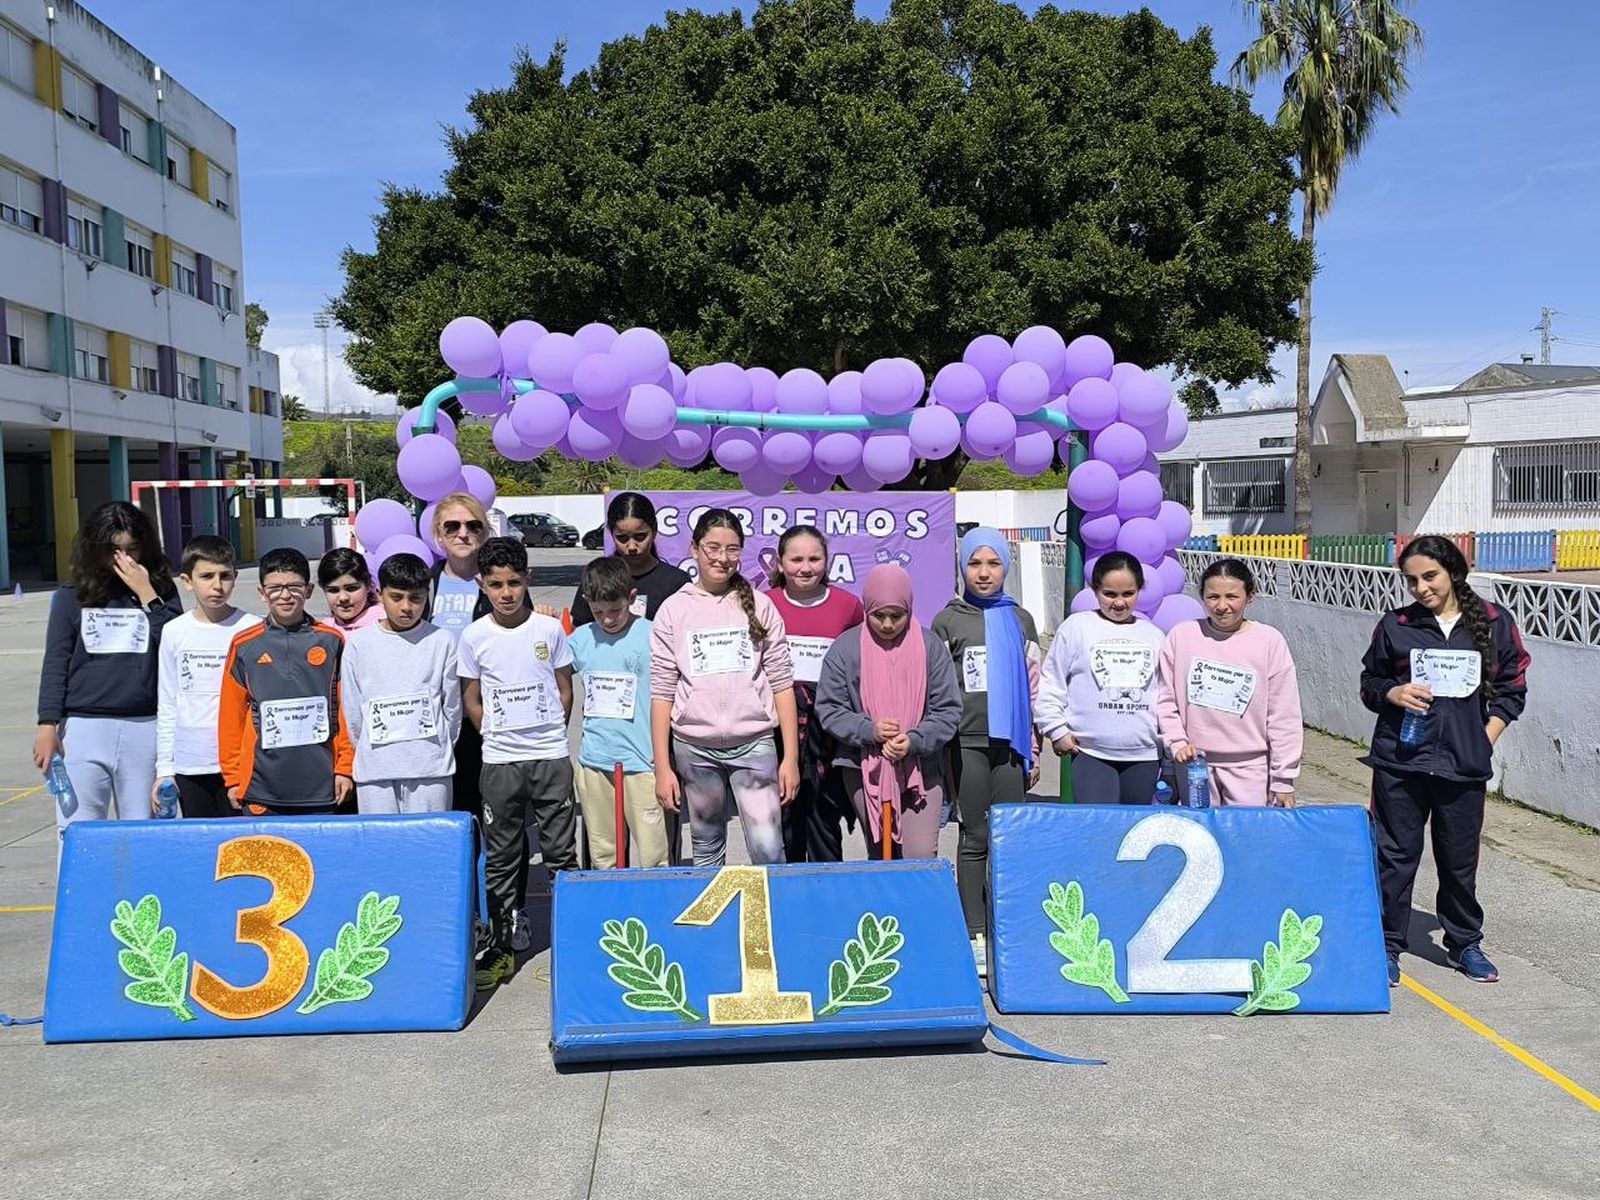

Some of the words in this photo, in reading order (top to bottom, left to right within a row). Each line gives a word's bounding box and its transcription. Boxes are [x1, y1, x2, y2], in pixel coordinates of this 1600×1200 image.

[380, 701, 409, 709] Corremos
[1204, 664, 1232, 674] Corremos
[190, 835, 315, 1020] 3
[673, 865, 814, 1025] 1
[1116, 813, 1254, 993] 2
